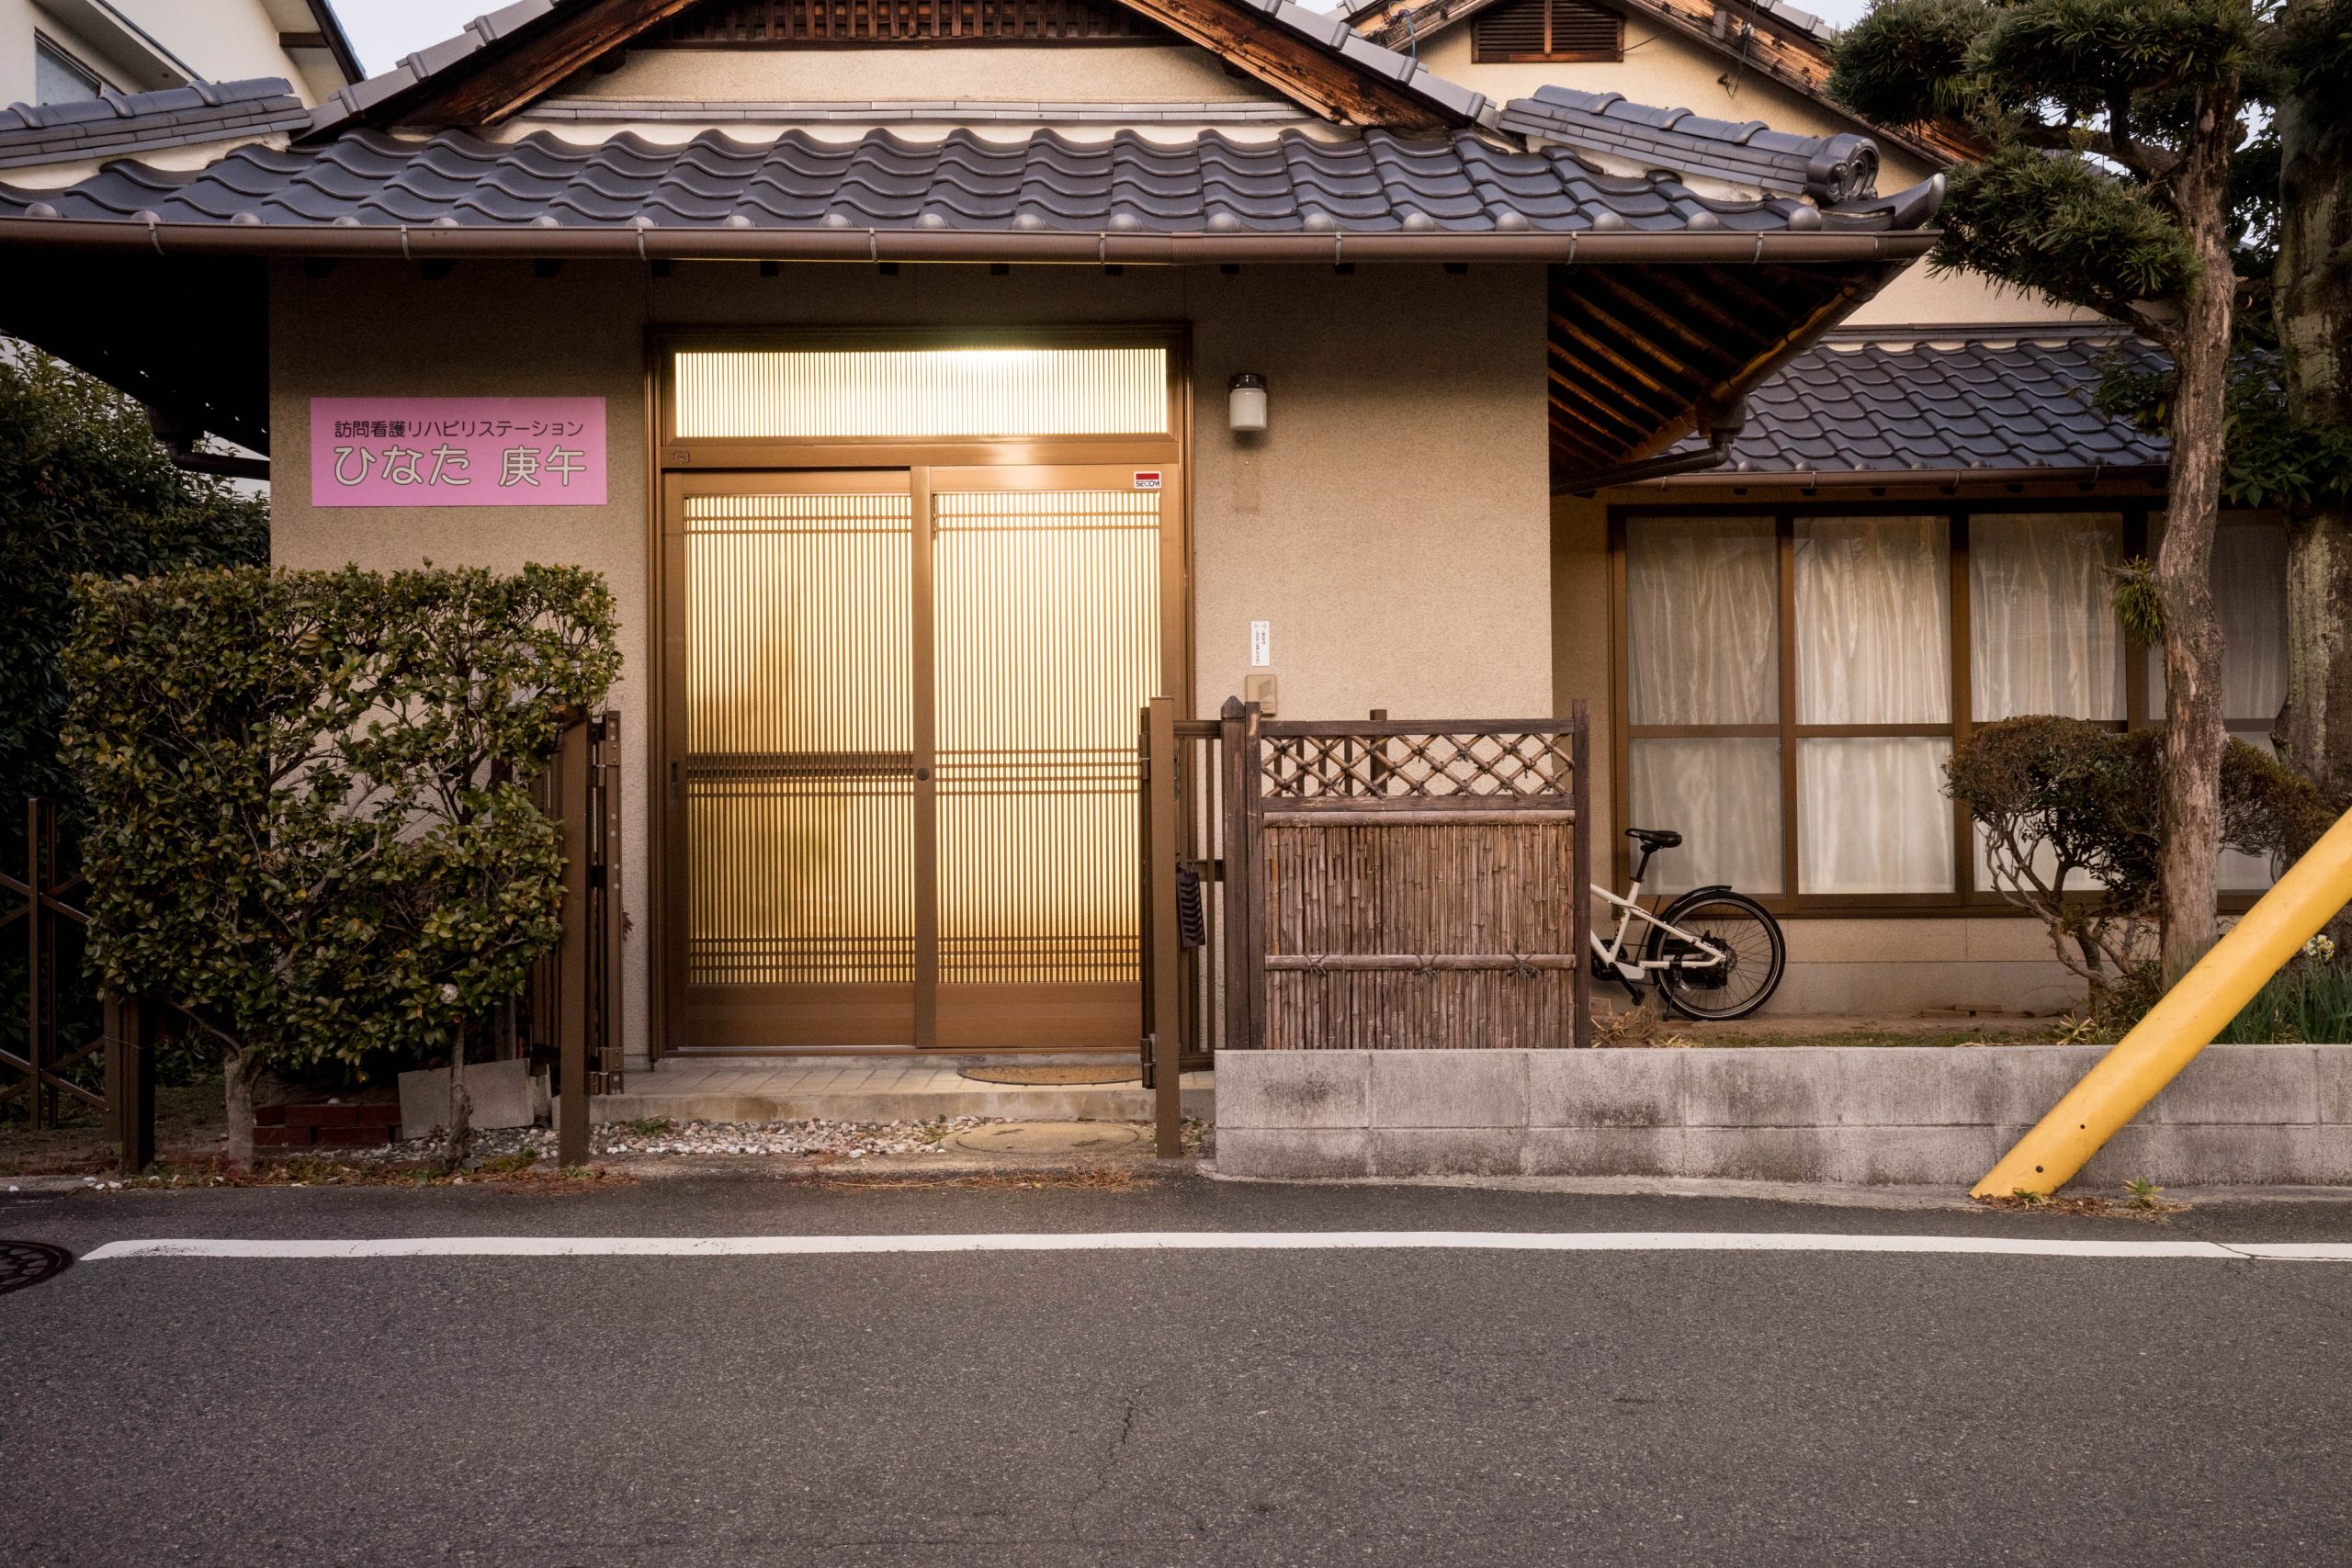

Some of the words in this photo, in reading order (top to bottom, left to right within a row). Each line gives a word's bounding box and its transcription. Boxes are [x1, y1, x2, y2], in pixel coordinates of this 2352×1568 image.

[334, 421, 583, 438] 訪問看護リハビリステーション
[334, 444, 470, 486] ひなた
[499, 445, 586, 487] 庚午
